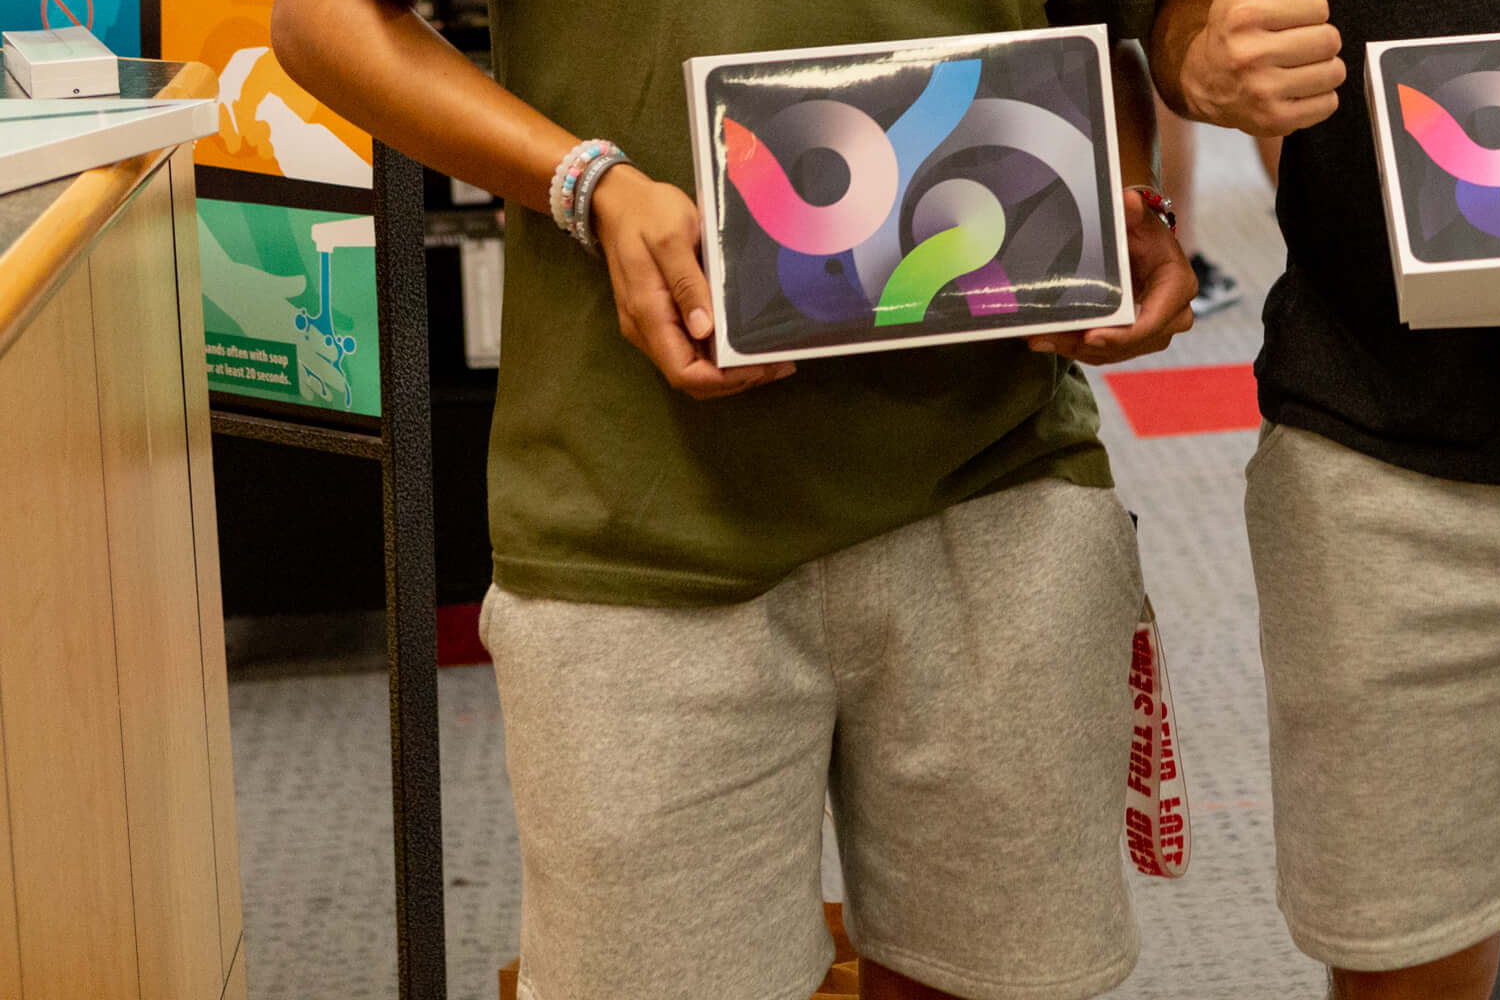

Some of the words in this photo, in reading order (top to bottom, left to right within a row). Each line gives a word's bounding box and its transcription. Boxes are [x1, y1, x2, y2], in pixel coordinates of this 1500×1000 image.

[226, 345, 248, 360] often
[268, 353, 289, 369] soap
[1128, 628, 1154, 716] SEND
[1127, 725, 1153, 798] FULL
